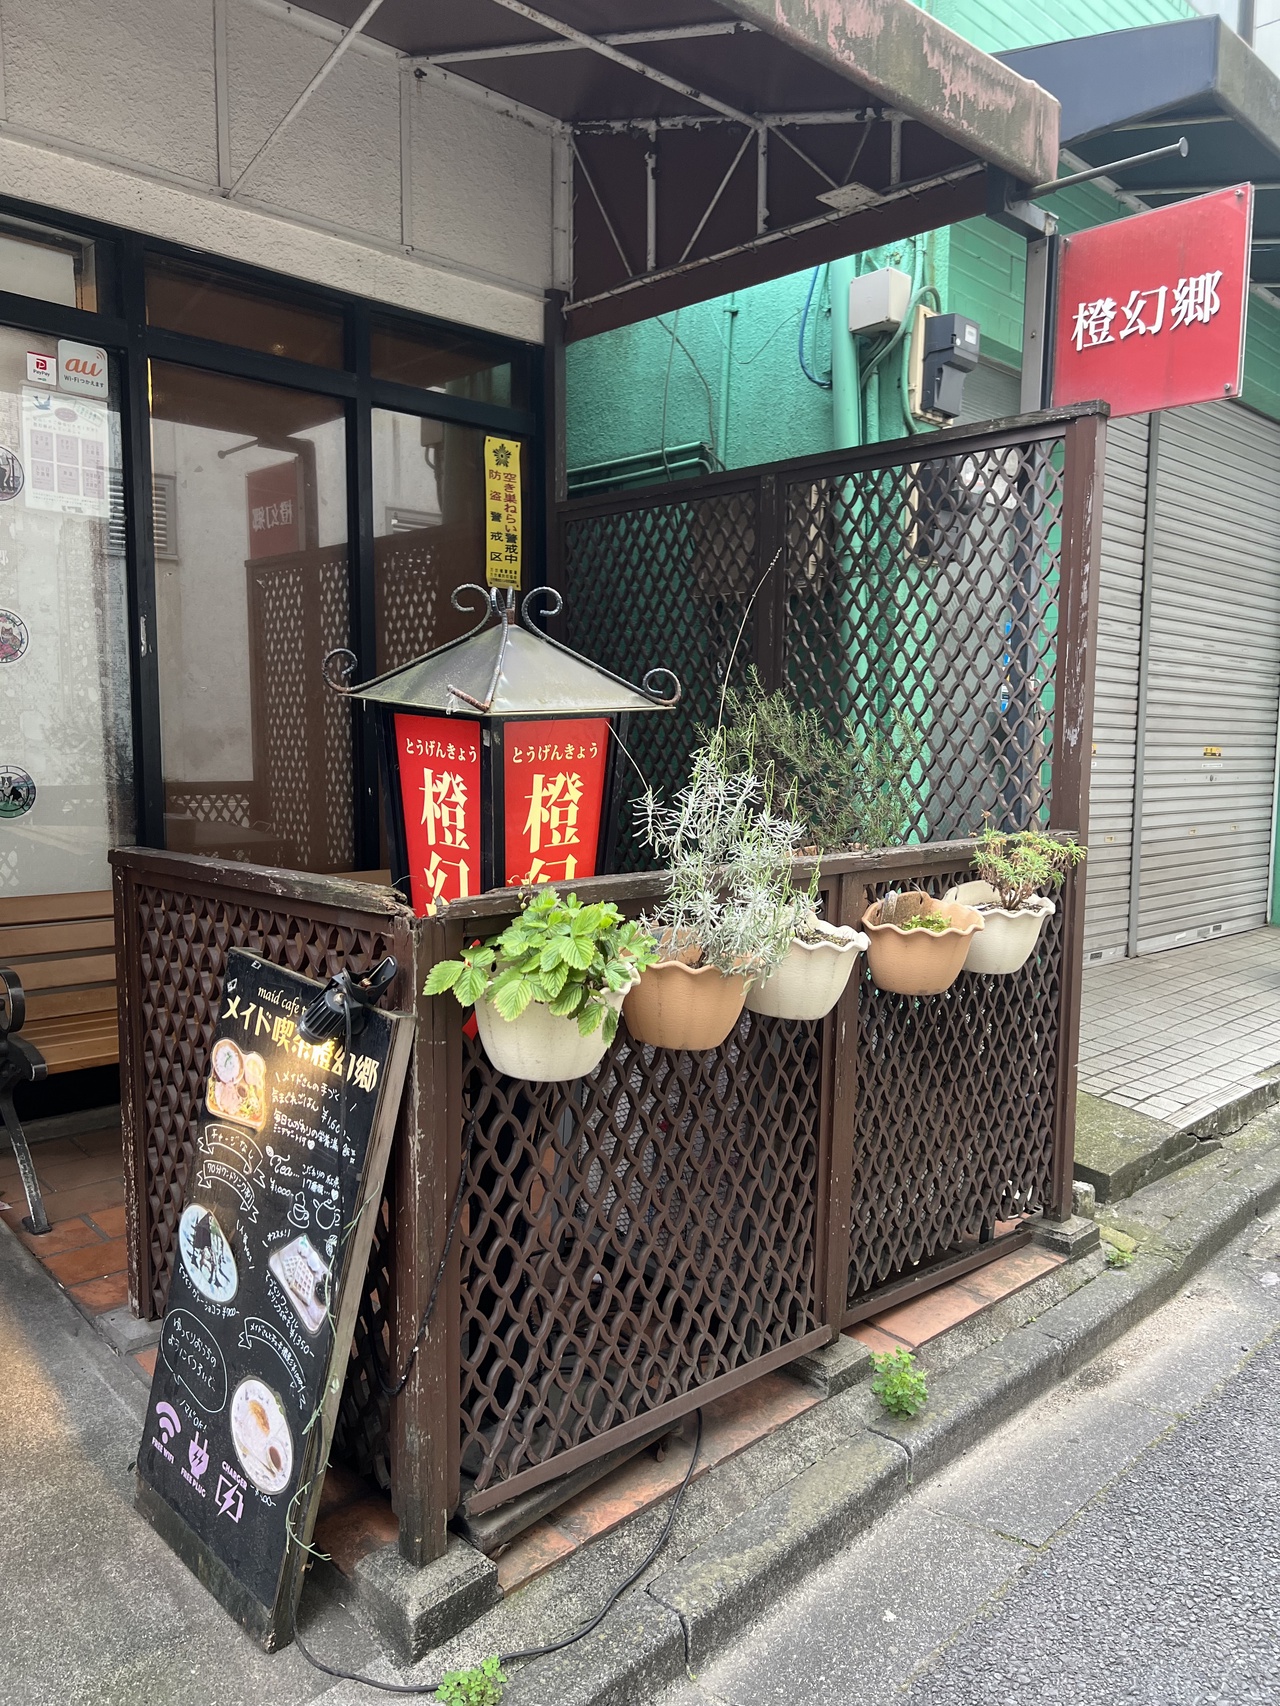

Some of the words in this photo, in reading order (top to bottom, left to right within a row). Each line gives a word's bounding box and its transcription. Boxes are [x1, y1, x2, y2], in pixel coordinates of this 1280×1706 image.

[1070, 270, 1223, 351] 橙幻郷
[33, 368, 50, 377] PayPay
[65, 357, 103, 377] au
[503, 471, 519, 564] 空き巣ねらい警戒中
[405, 737, 478, 763] とうげんきょう
[512, 742, 599, 764] とうげんきょう
[258, 985, 283, 1005] maid
[281, 998, 300, 1018] cafe
[211, 1128, 254, 1159] チャージなし
[151, 1436, 164, 1456] FREE
[180, 1466, 193, 1485] FREE
[191, 1478, 207, 1498] PLUG
[221, 1460, 248, 1491] CHARGER
